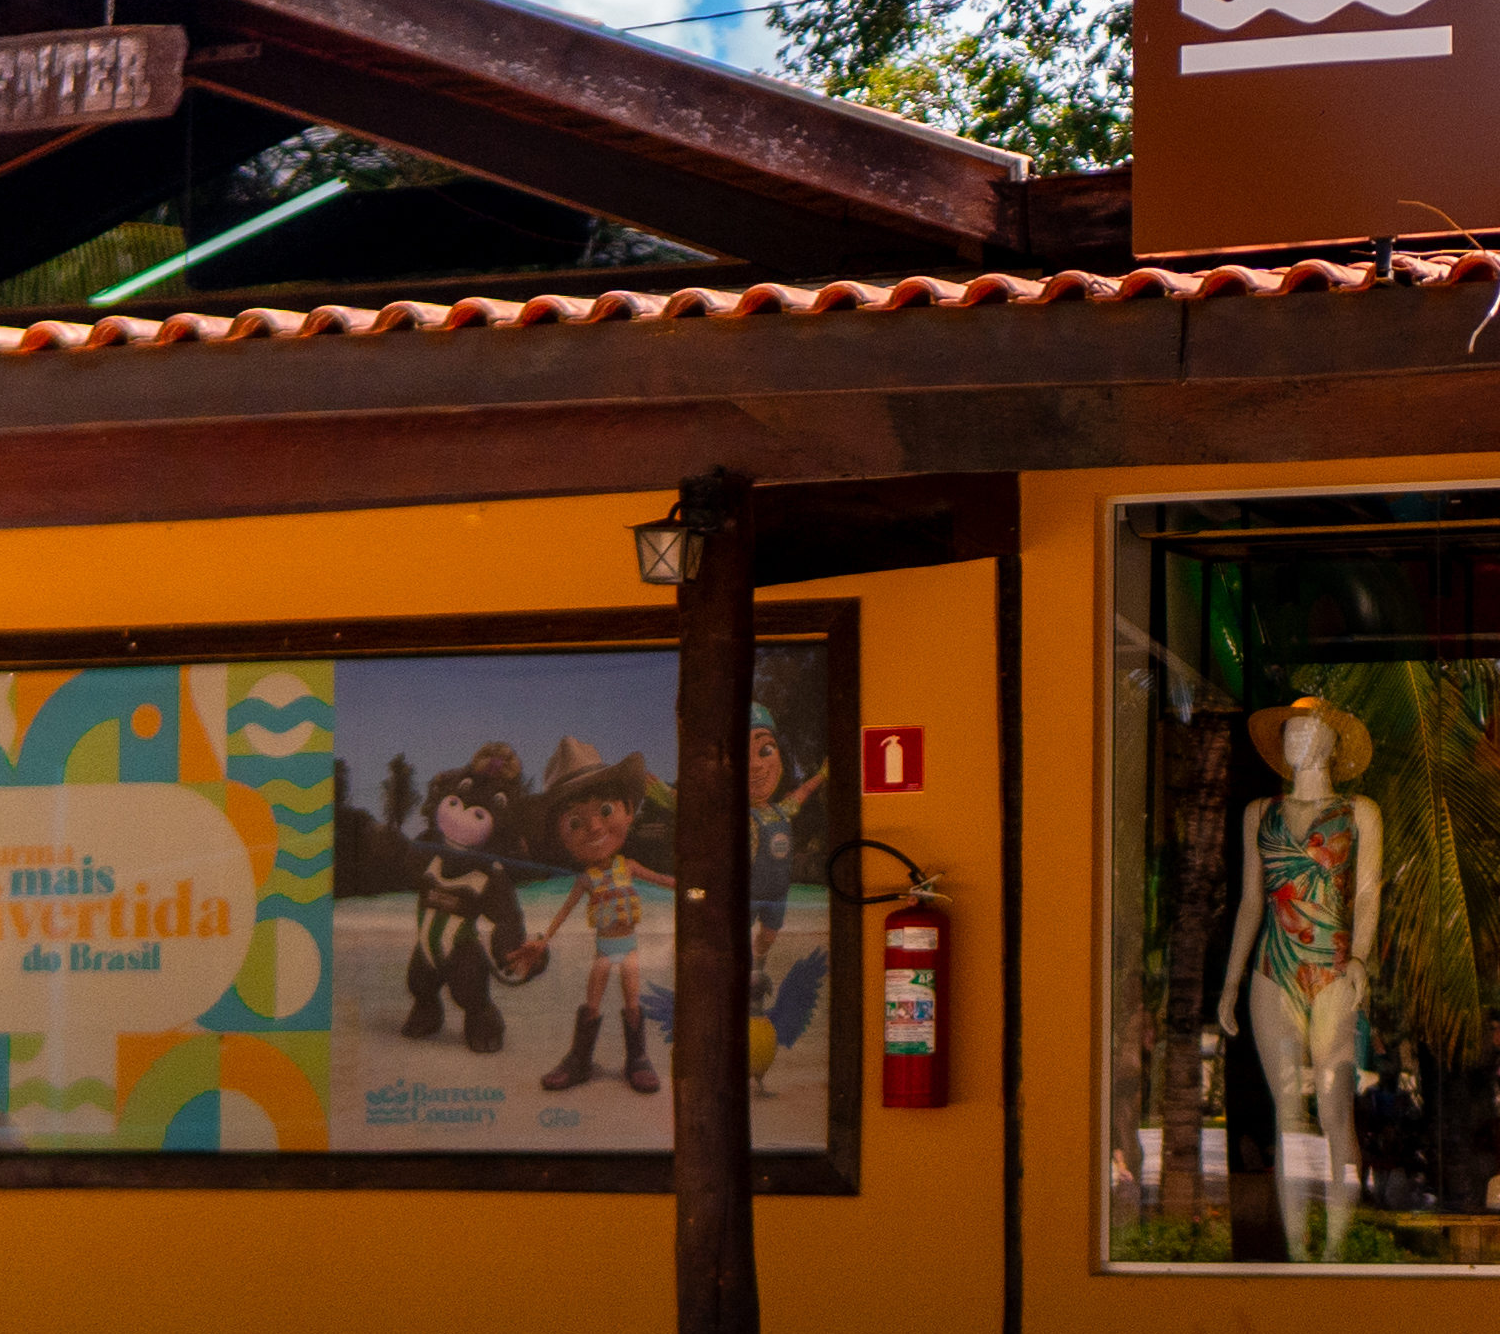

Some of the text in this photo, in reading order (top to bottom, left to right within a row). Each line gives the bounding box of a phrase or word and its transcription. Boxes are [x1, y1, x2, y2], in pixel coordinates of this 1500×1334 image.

[9, 856, 115, 896] mais
[22, 942, 161, 973] do Brasil
